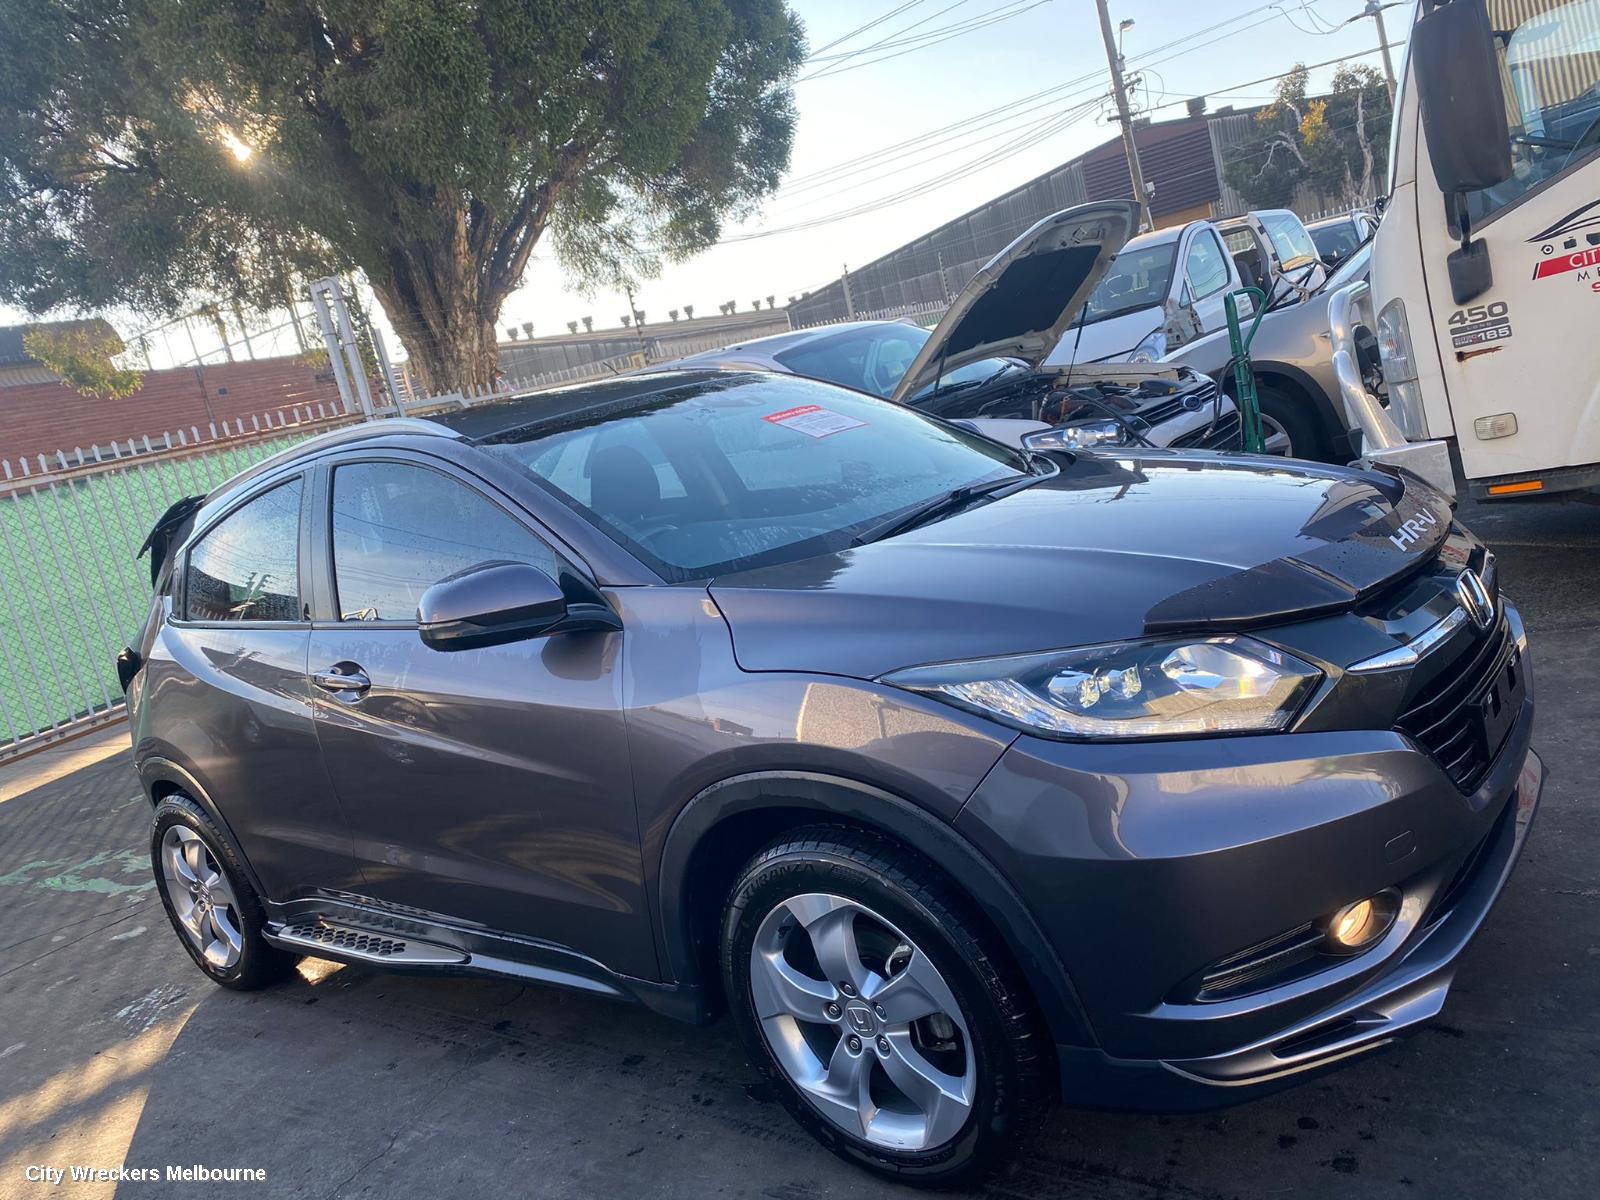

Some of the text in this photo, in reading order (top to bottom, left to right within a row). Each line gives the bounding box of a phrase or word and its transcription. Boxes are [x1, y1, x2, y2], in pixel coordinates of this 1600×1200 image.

[1569, 247, 1600, 267] CIT
[1448, 302, 1508, 325] 450
[1477, 326, 1510, 342] 185
[1388, 507, 1437, 552] HR-V
